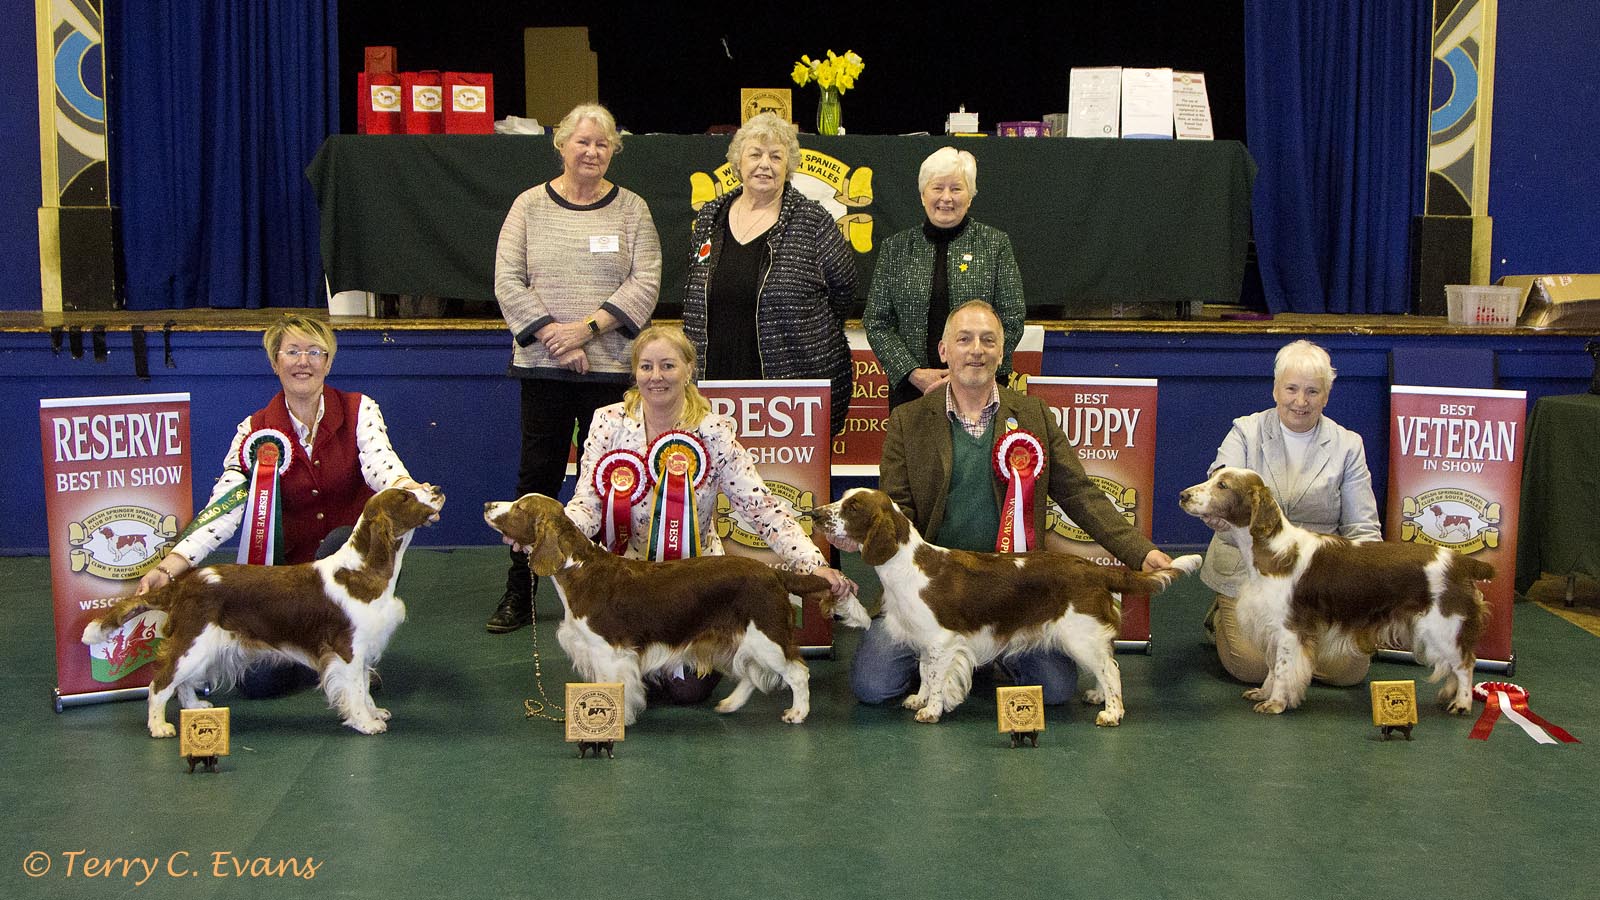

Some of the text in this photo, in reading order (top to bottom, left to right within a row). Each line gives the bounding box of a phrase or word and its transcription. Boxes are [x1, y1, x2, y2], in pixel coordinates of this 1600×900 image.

[805, 154, 840, 174] SPANIEL
[808, 164, 839, 183] WALES
[726, 176, 737, 186] CL
[1074, 394, 1109, 405] BEST
[709, 396, 822, 438] BEST
[1440, 404, 1475, 416] BEST
[52, 411, 182, 462] RESERVE
[1397, 416, 1516, 462] VETERAN
[746, 446, 814, 464] SHOW
[1078, 449, 1119, 460] SHOW
[1423, 460, 1484, 473] IN SHOW
[56, 466, 183, 492] BEST IN SHOW
[1101, 480, 1119, 490] SPANIEL
[777, 483, 796, 495] SPANIEL
[779, 489, 794, 499] WALES
[1102, 485, 1118, 496] WALES
[1421, 492, 1437, 500] WELSH
[1465, 493, 1483, 504] SPANIEL
[1422, 498, 1434, 506] CLUB
[1465, 498, 1481, 508] WALES
[257, 490, 268, 527] RESERVE
[88, 513, 105, 524] WELSH
[136, 509, 157, 519] SPANIEL
[89, 520, 103, 530] CLUB
[137, 515, 156, 525] WALES
[669, 520, 679, 550] BEST
